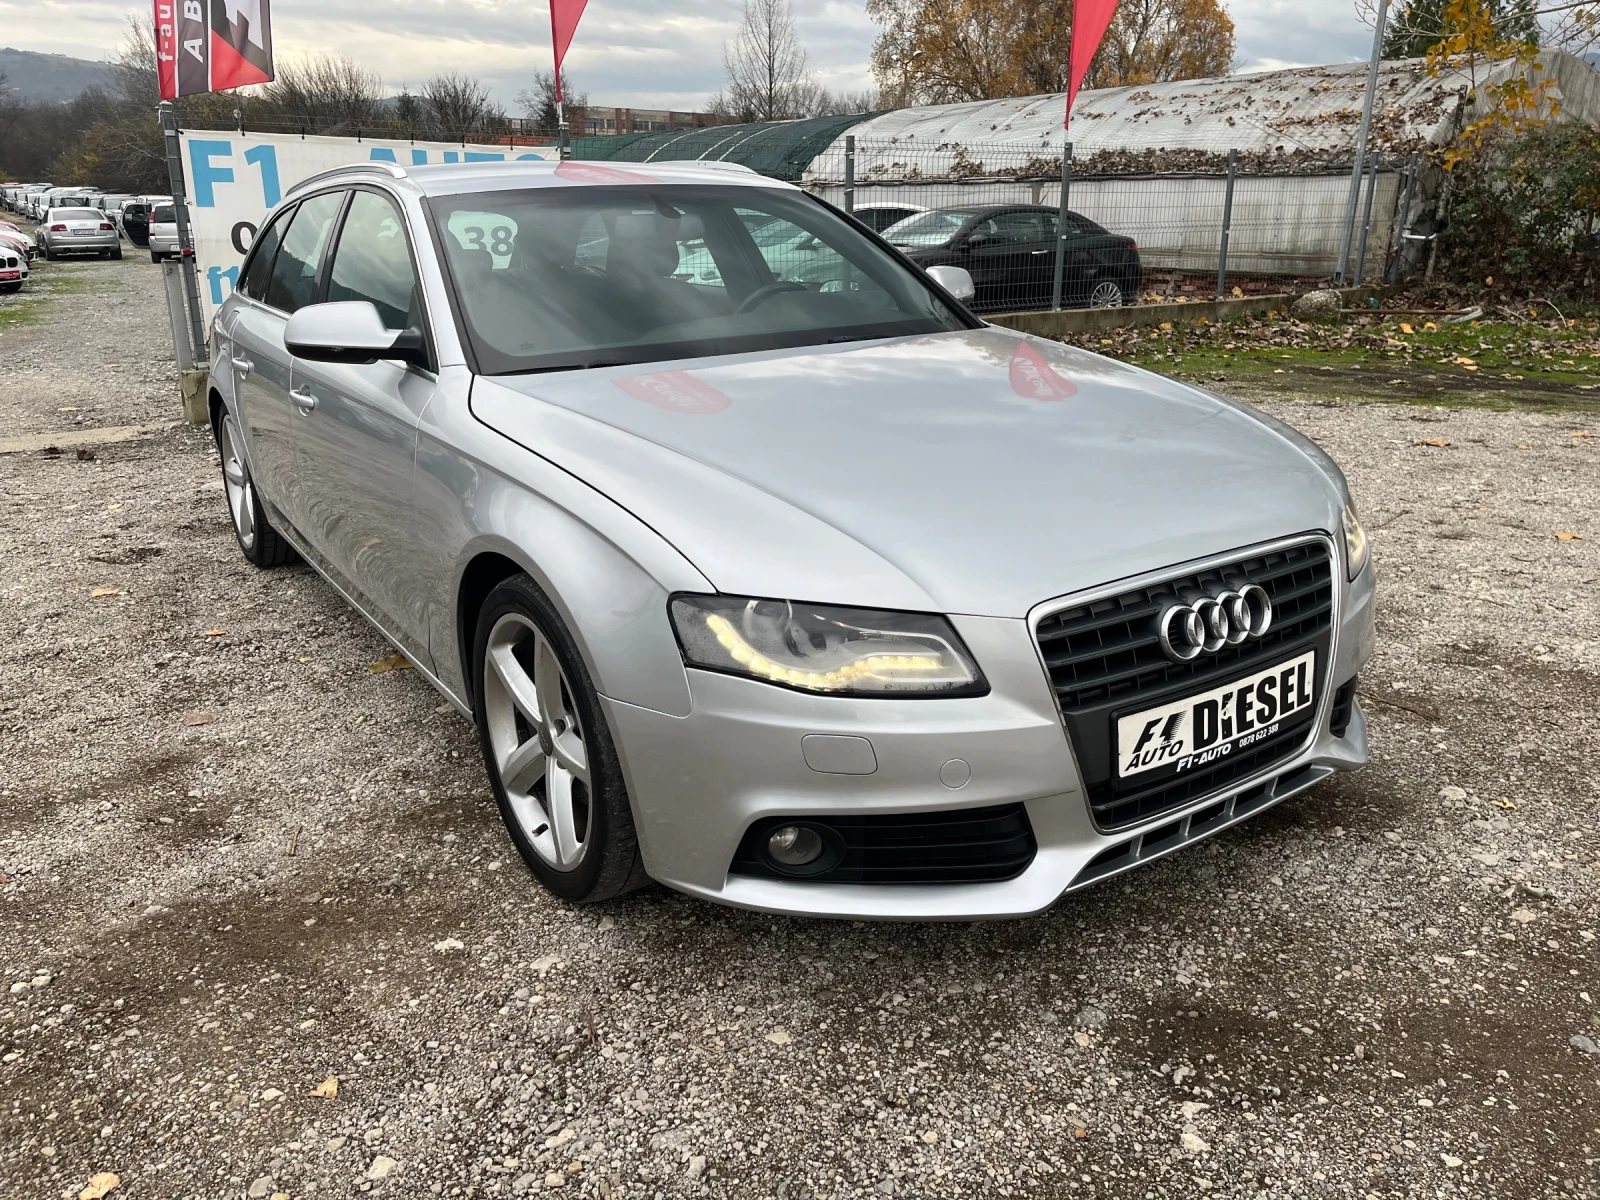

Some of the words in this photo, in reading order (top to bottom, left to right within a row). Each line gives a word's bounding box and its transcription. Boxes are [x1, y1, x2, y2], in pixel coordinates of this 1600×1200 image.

[158, 0, 173, 62] f-au
[188, 139, 282, 209] F1
[464, 226, 514, 257] 38
[1193, 661, 1311, 752] DIESEL
[1132, 710, 1188, 754] F1
[1238, 734, 1255, 748] 0878
[1255, 728, 1268, 741] 622
[1124, 740, 1184, 772] AUTO
[1176, 743, 1232, 773] F1-AUTO
